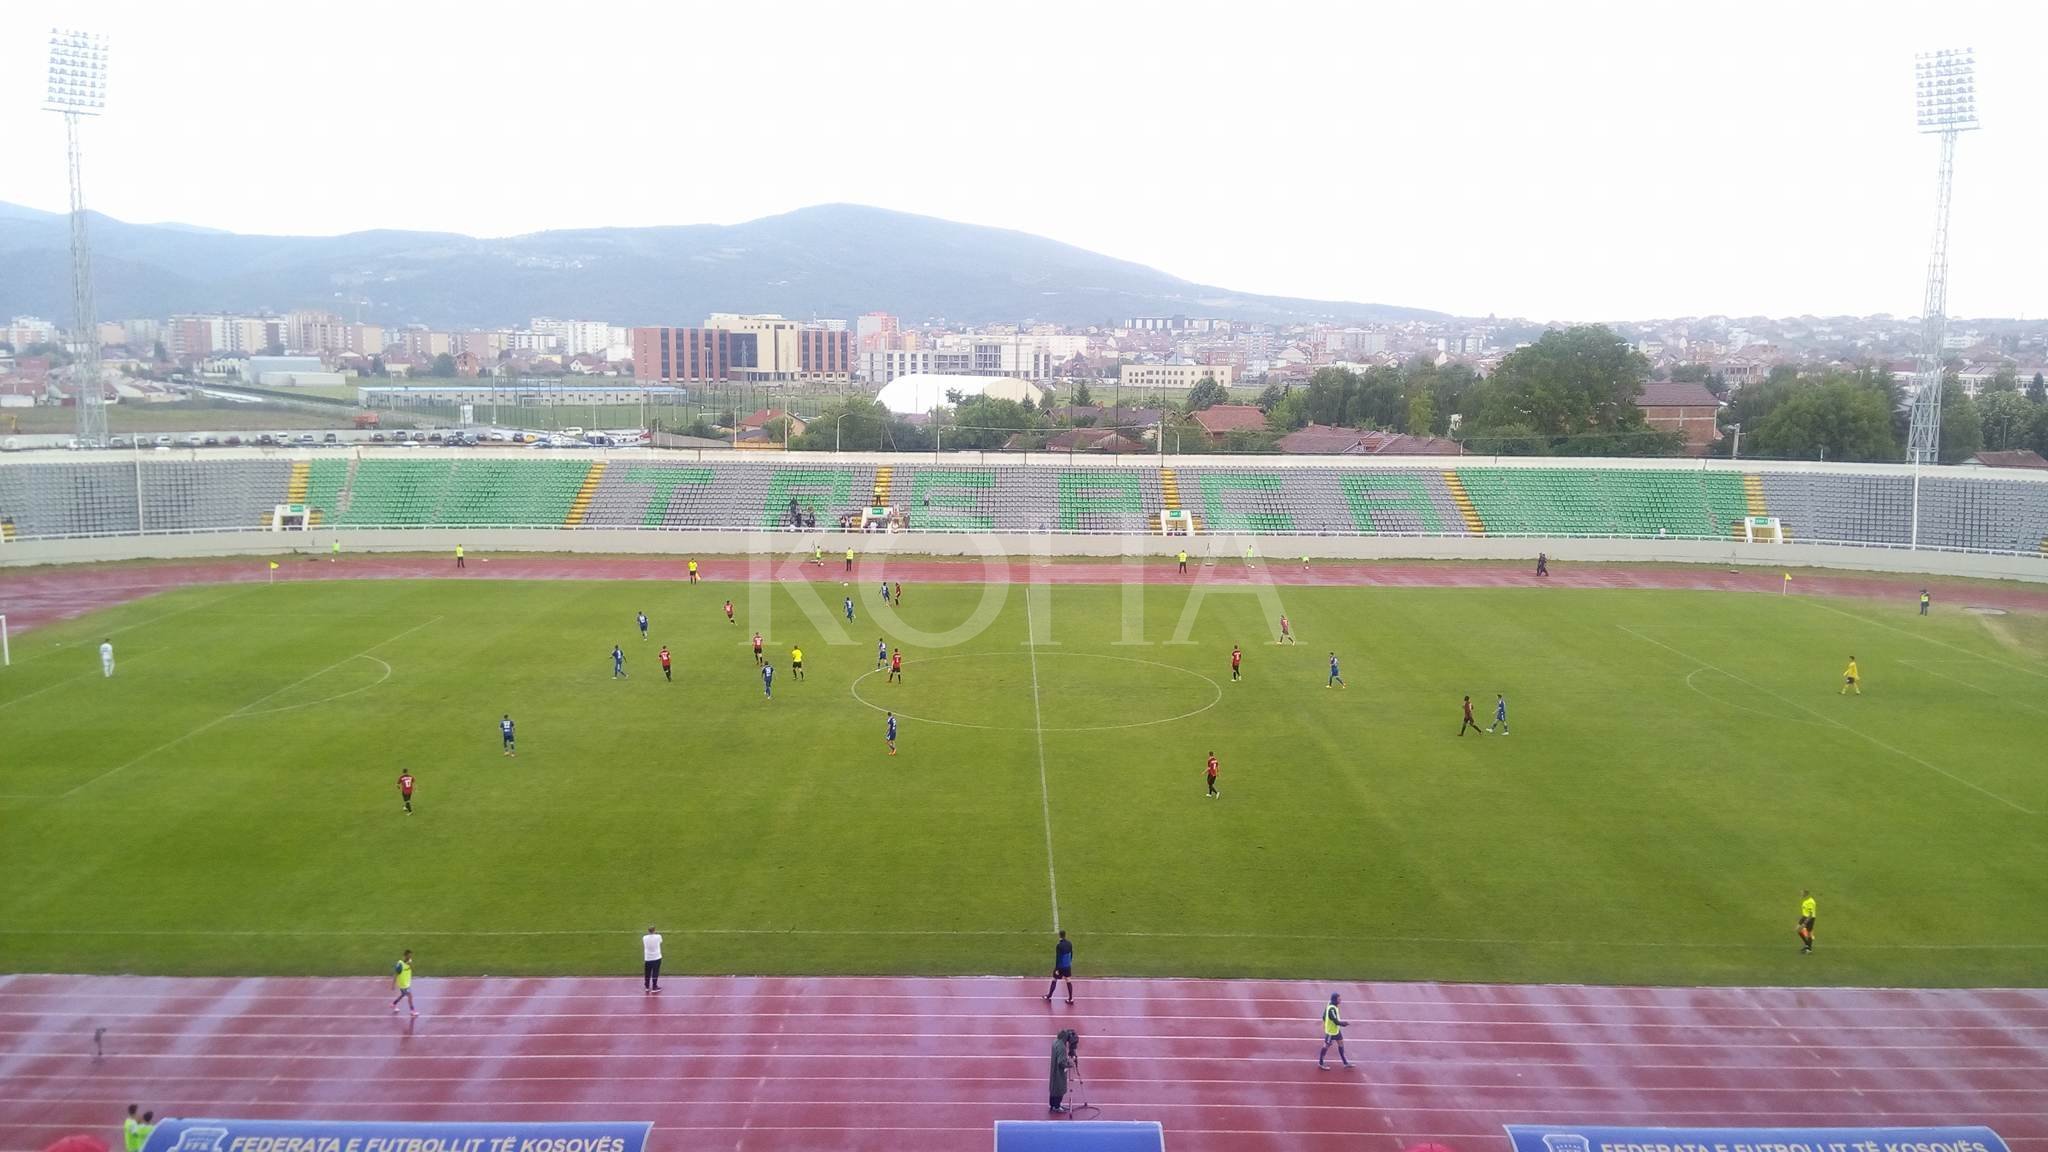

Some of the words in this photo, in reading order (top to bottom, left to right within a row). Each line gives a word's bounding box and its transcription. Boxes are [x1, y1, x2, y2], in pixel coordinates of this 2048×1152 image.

[230, 1137, 341, 1152] FEDERATA
[346, 1138, 362, 1152] E
[366, 1138, 485, 1152] FUTBOLLIT
[490, 1136, 517, 1152] TË
[519, 1136, 625, 1152] KOSOVËS
